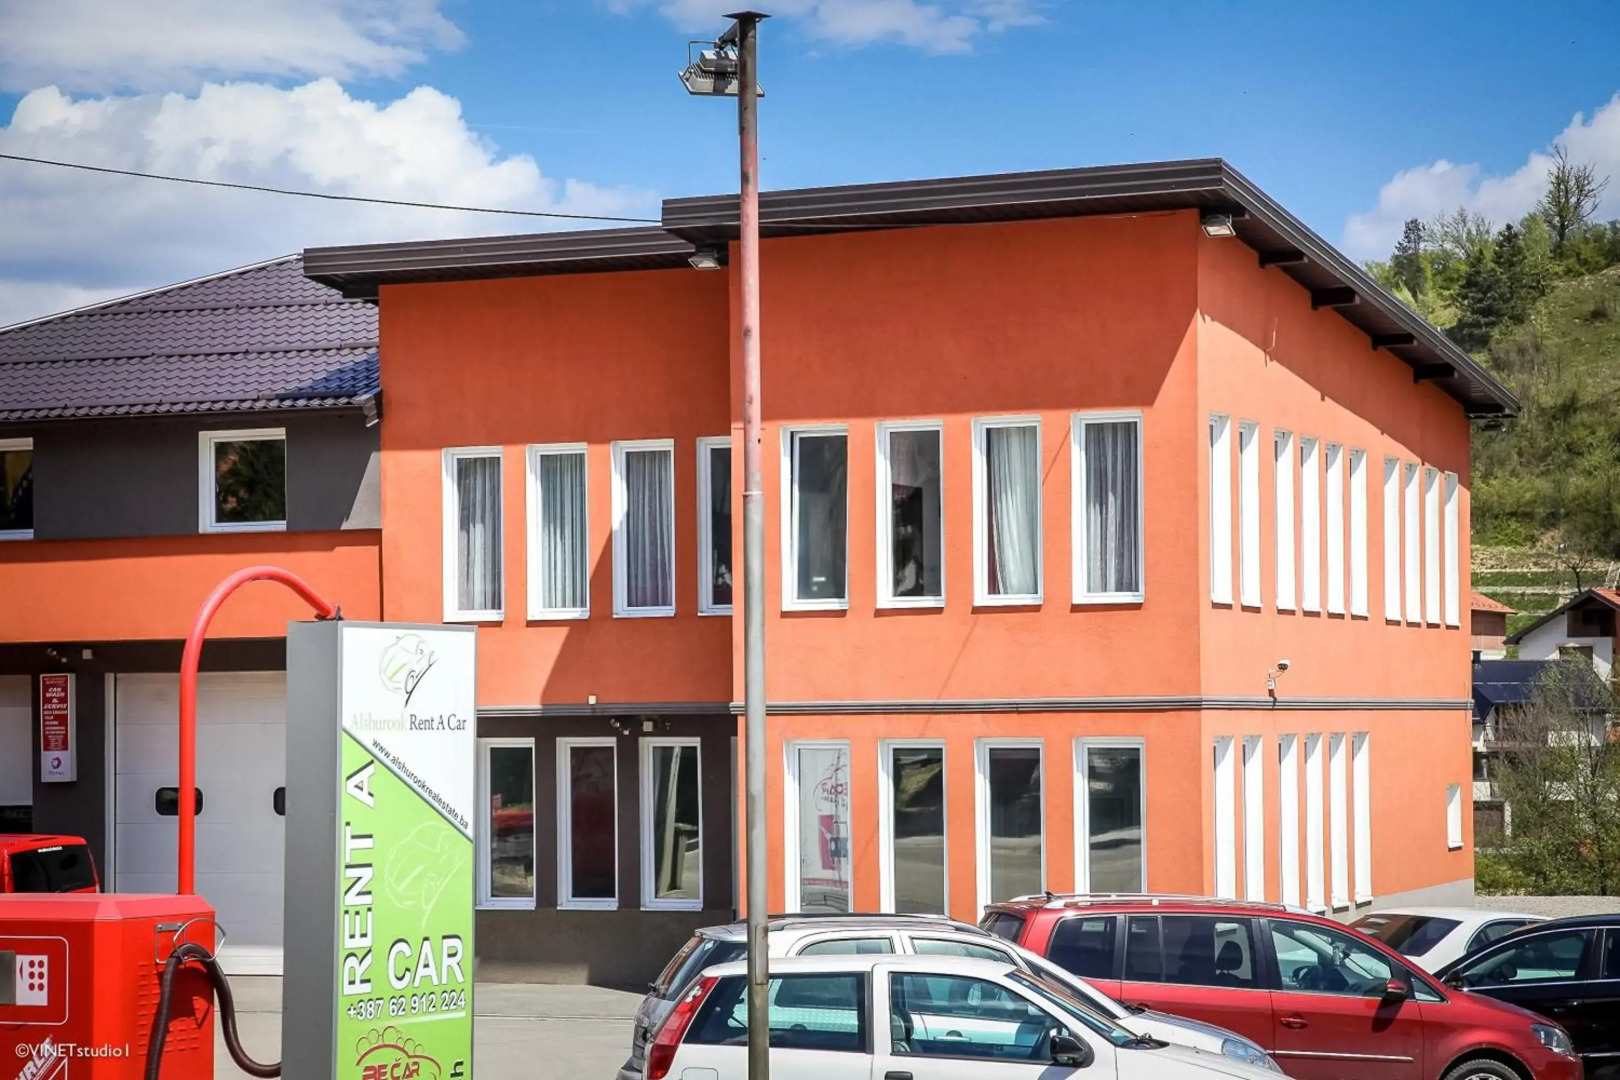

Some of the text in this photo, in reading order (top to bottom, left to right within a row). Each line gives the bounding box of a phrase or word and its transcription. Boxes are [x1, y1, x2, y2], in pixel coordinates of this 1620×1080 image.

[350, 713, 467, 731] Alshurook Rent A Car
[372, 738, 469, 829] www.alshurookrealestate.ba
[343, 759, 375, 996] RENT A
[387, 934, 465, 991] CAR
[347, 989, 466, 1021] +387 62 912 224
